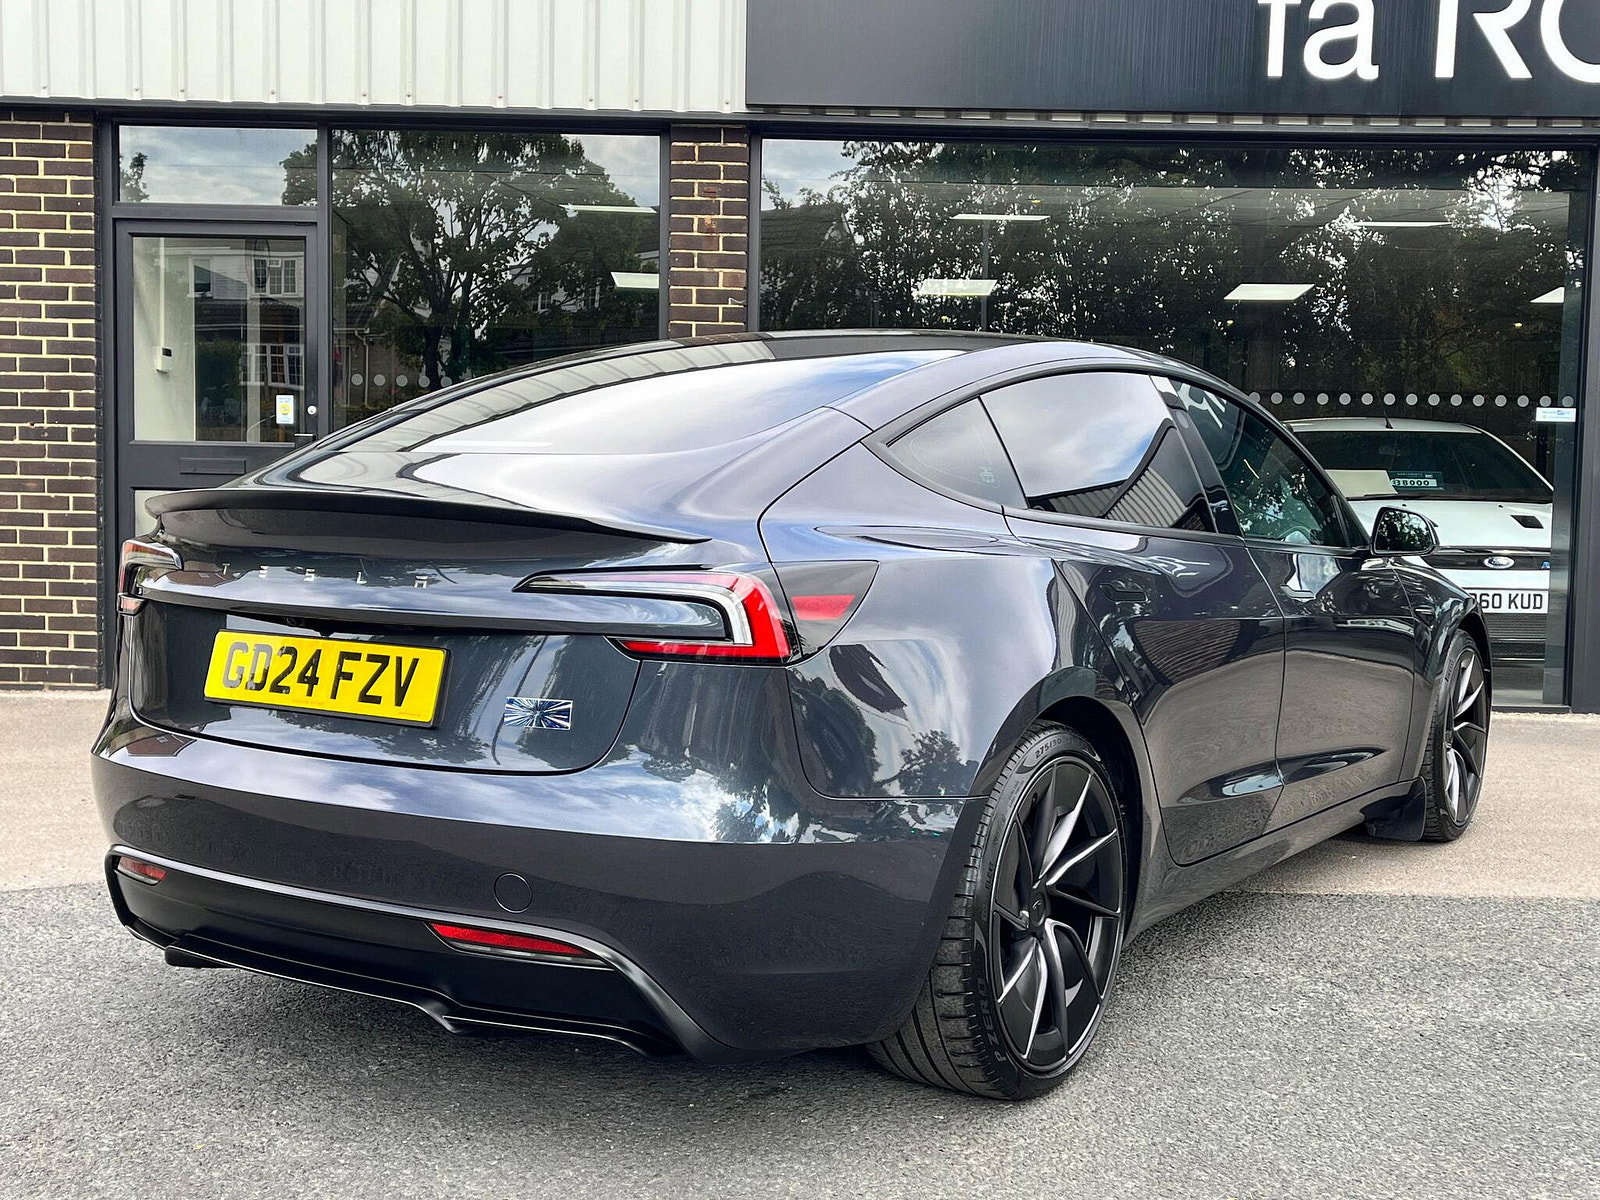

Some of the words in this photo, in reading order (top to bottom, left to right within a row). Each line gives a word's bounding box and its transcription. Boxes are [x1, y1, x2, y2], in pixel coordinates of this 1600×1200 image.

[222, 563, 428, 589] TESLA
[1508, 593, 1543, 610] KUD
[222, 641, 322, 697] GD24
[330, 651, 420, 708] FZV
